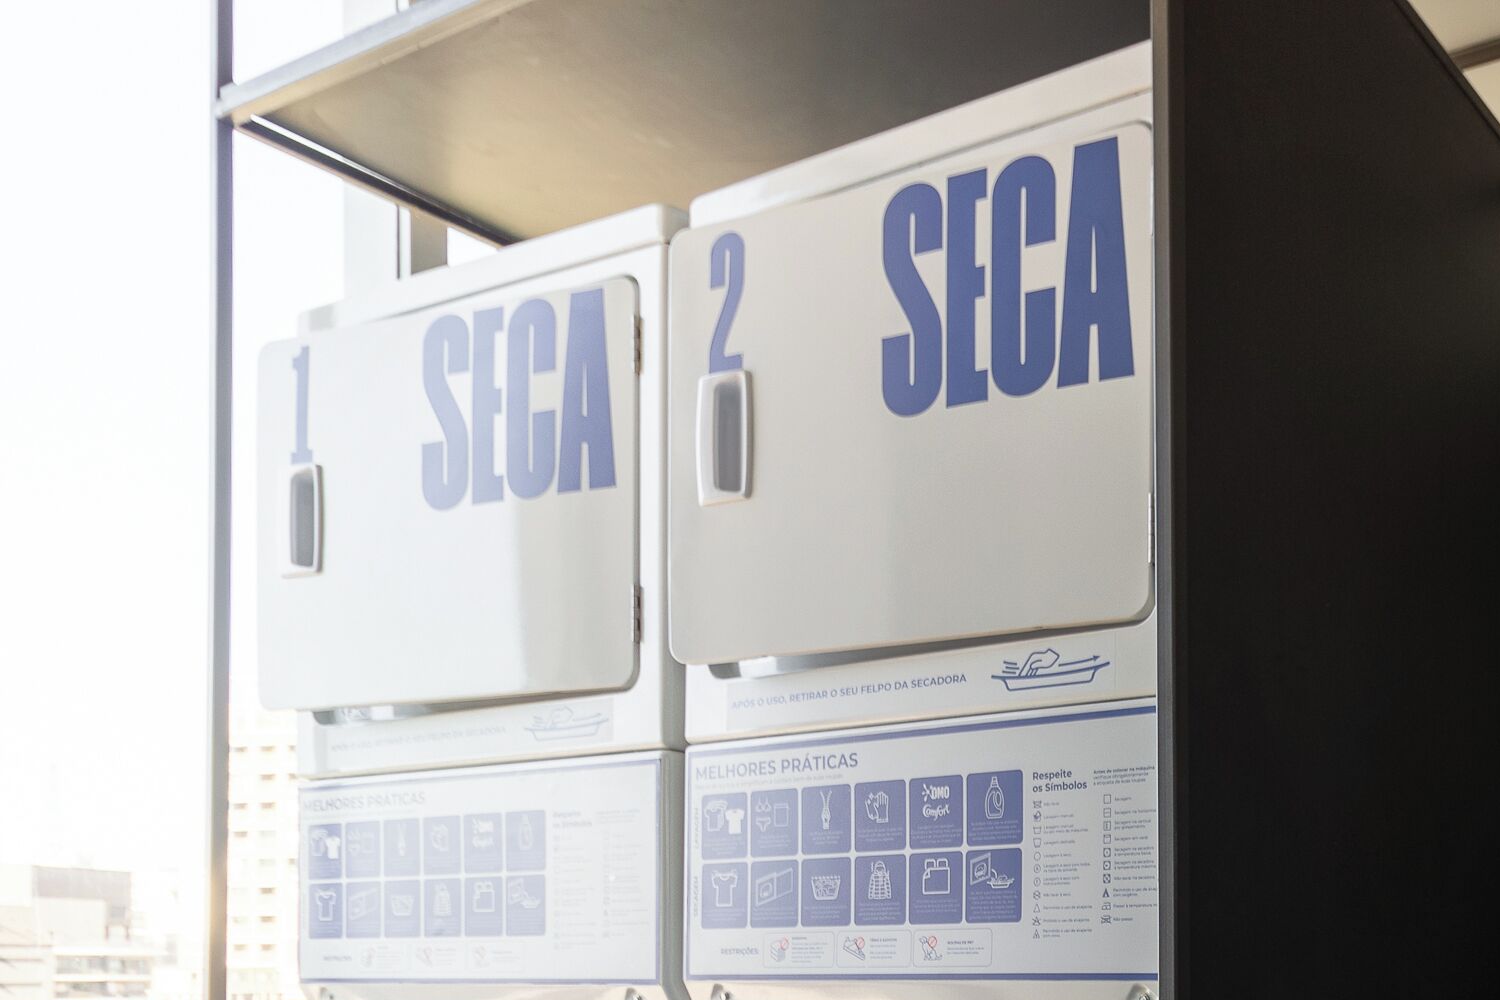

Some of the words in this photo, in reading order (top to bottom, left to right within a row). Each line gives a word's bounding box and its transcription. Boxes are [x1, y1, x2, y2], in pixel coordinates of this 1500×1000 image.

[880, 135, 1135, 419] SECA
[708, 230, 746, 374] 2
[290, 345, 314, 465] 1
[420, 287, 617, 512] SECA
[789, 689, 828, 703] RETIRAR
[830, 689, 838, 698] O
[840, 687, 859, 697] SEU
[860, 682, 892, 694] FELPO
[894, 680, 909, 691] DA
[911, 673, 967, 689] SECADORA
[695, 760, 776, 781] MELHORES
[781, 752, 858, 773] PRÁTICAS
[1032, 769, 1072, 781] Respeite
[931, 785, 950, 799] OMO
[1032, 785, 1043, 793] os
[1045, 780, 1088, 792] Símbolos
[922, 804, 950, 821] Comfort
